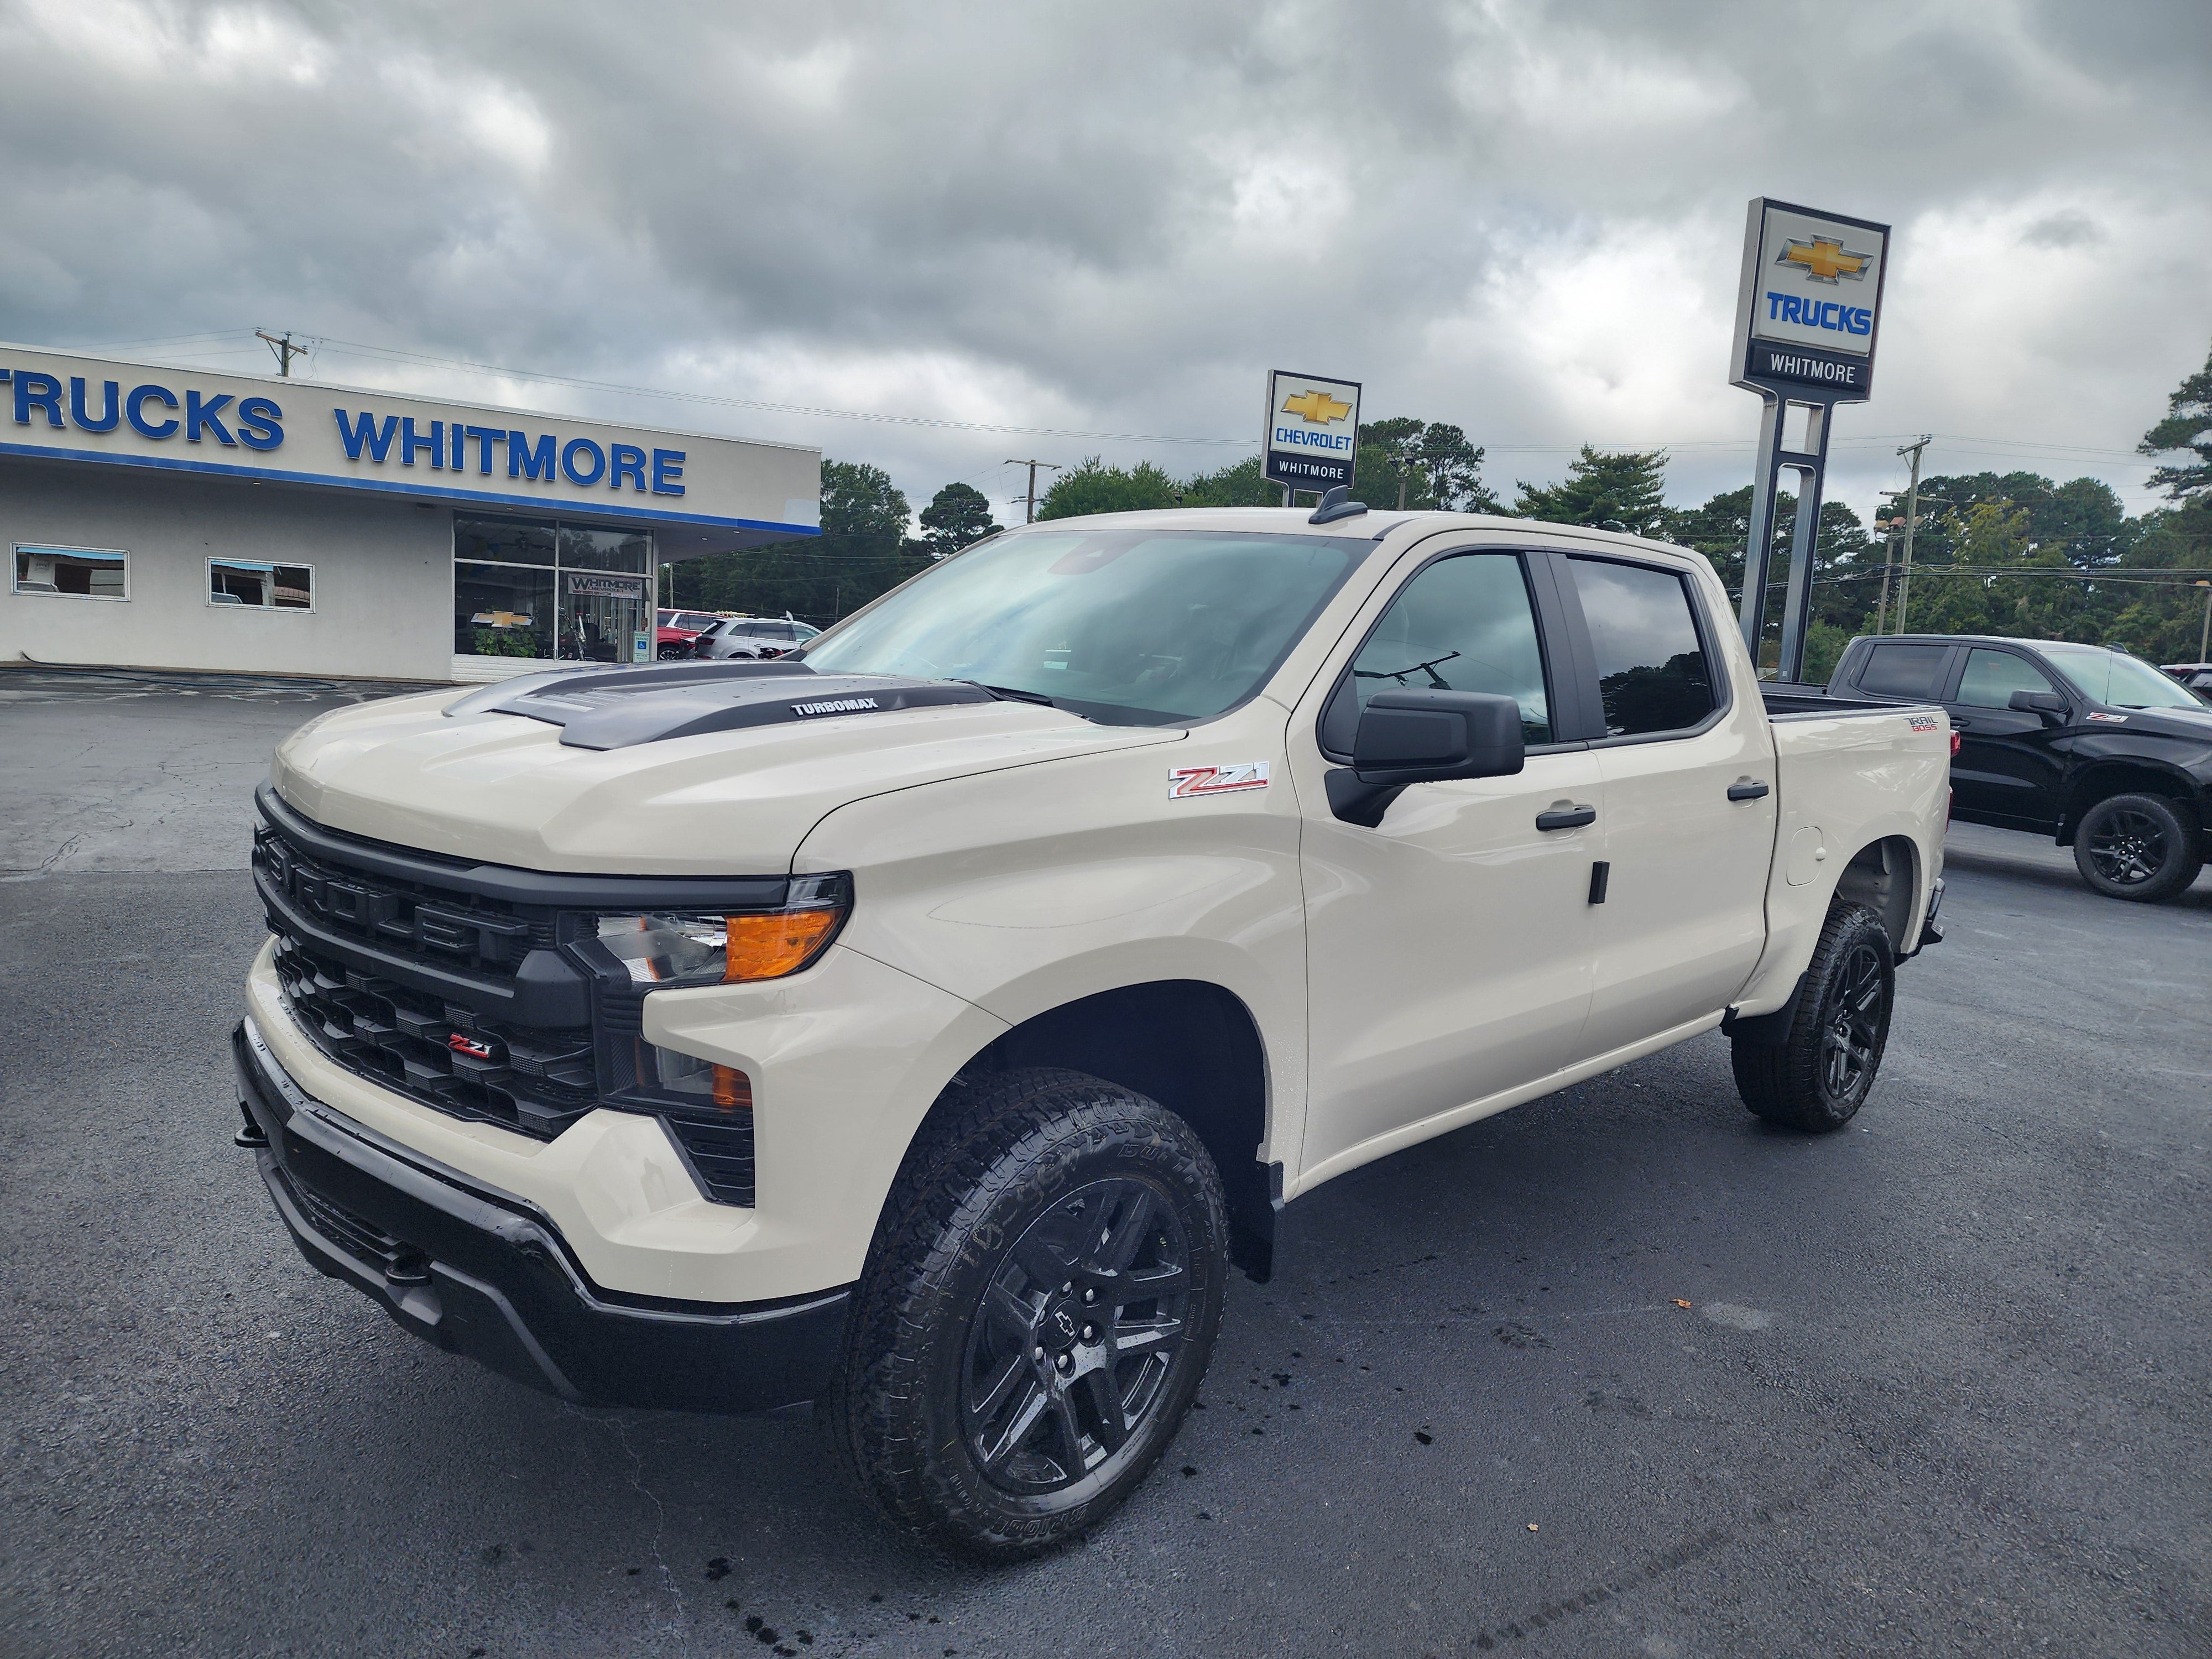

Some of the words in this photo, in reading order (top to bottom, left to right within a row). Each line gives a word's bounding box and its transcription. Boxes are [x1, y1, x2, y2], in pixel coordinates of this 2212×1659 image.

[1766, 291, 1872, 336] TRUCKS
[1770, 353, 1856, 384] WHITMORE
[0, 368, 285, 451] RUCKS
[333, 408, 686, 496] WHITMORE
[1276, 427, 1352, 451] CHEVROLET
[1279, 460, 1345, 479] WHITMORE
[571, 577, 640, 592] WHITMORE
[790, 697, 879, 717] TURBOMAX
[2085, 712, 2130, 723] Z71
[1903, 716, 1939, 726] TRAIL
[1912, 724, 1938, 732] BOSS
[1168, 760, 1270, 800] Z71
[448, 1033, 493, 1058] Z71
